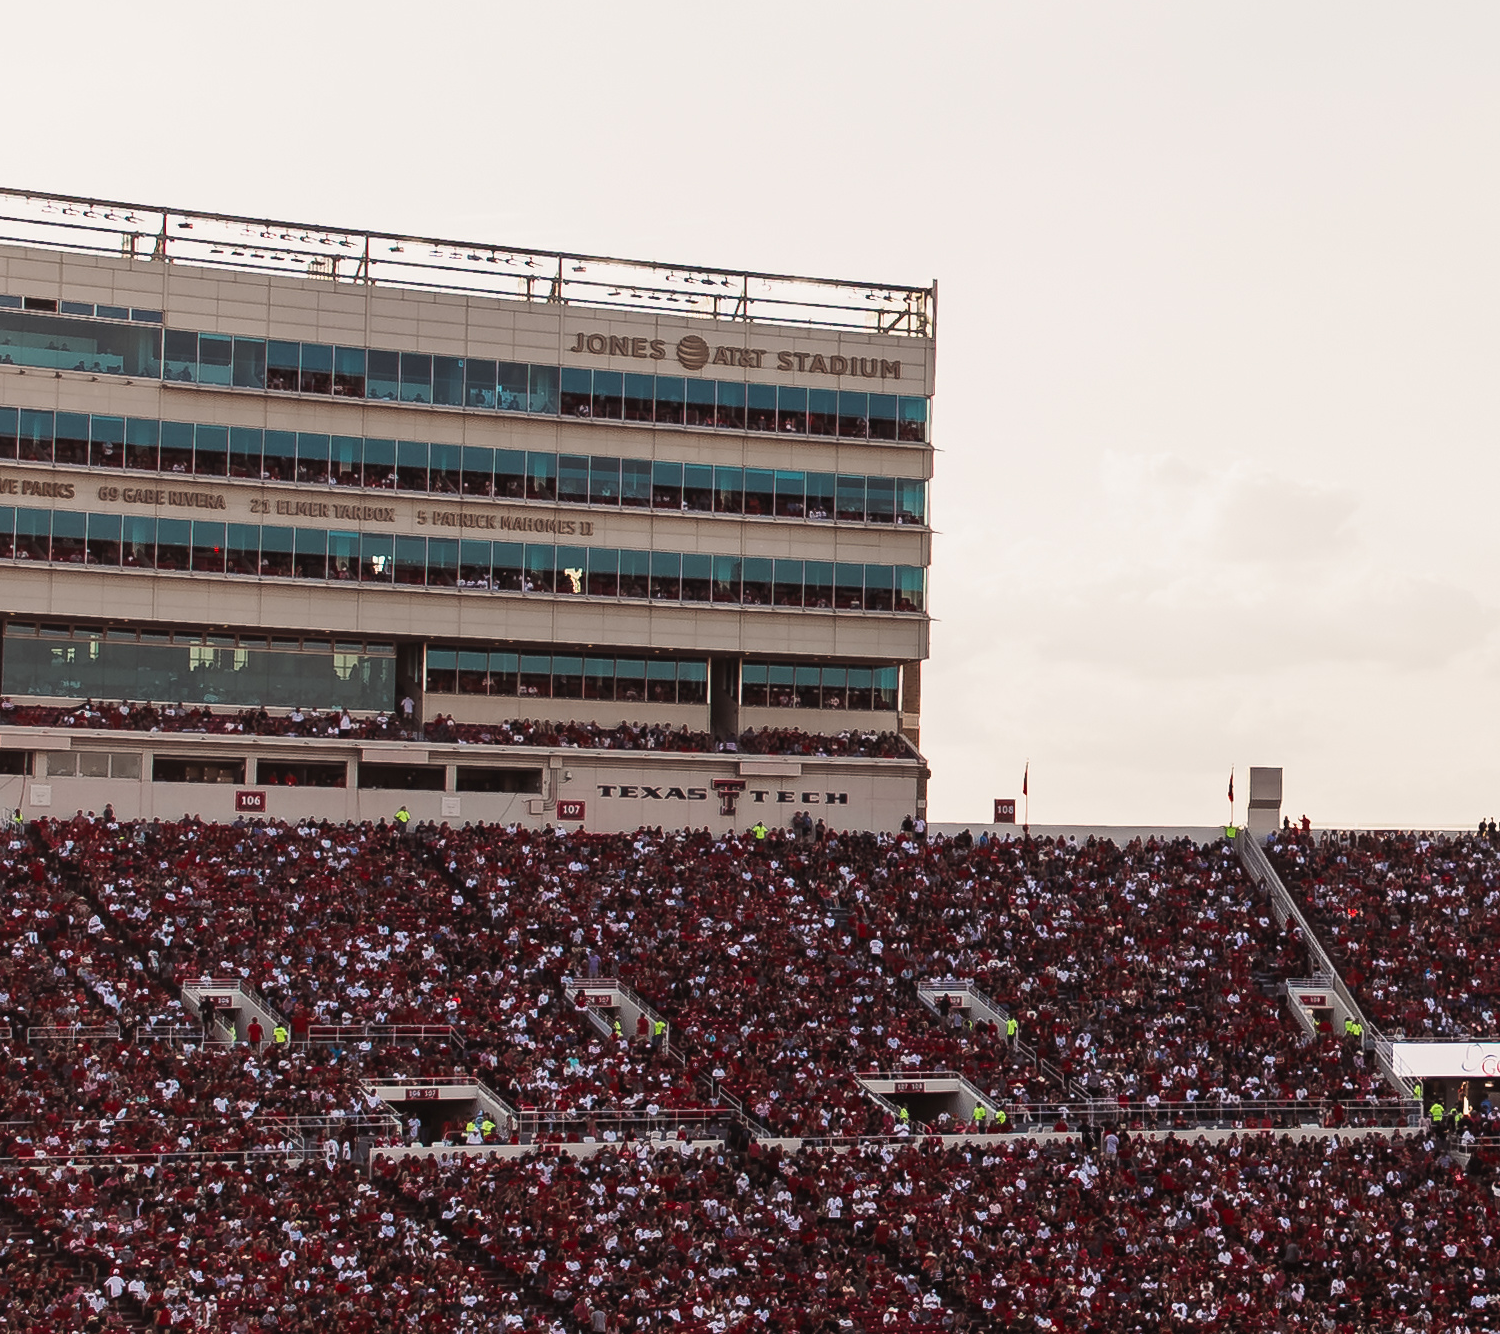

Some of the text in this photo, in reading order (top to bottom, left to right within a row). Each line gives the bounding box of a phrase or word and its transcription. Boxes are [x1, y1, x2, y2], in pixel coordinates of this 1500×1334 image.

[571, 332, 901, 379] JONES AT&T STADIUM
[20, 479, 75, 500] PARKS
[99, 485, 227, 510] 69 GABE RIVERA
[250, 498, 396, 524] 21 ELMER TARBOX
[416, 509, 428, 526] 5
[432, 510, 497, 530] PATRICK
[500, 513, 576, 536] MAHOMES
[240, 793, 262, 808] 106
[597, 785, 849, 805] TEXAS TECH
[562, 804, 581, 815] 107
[997, 805, 1014, 814] 108
